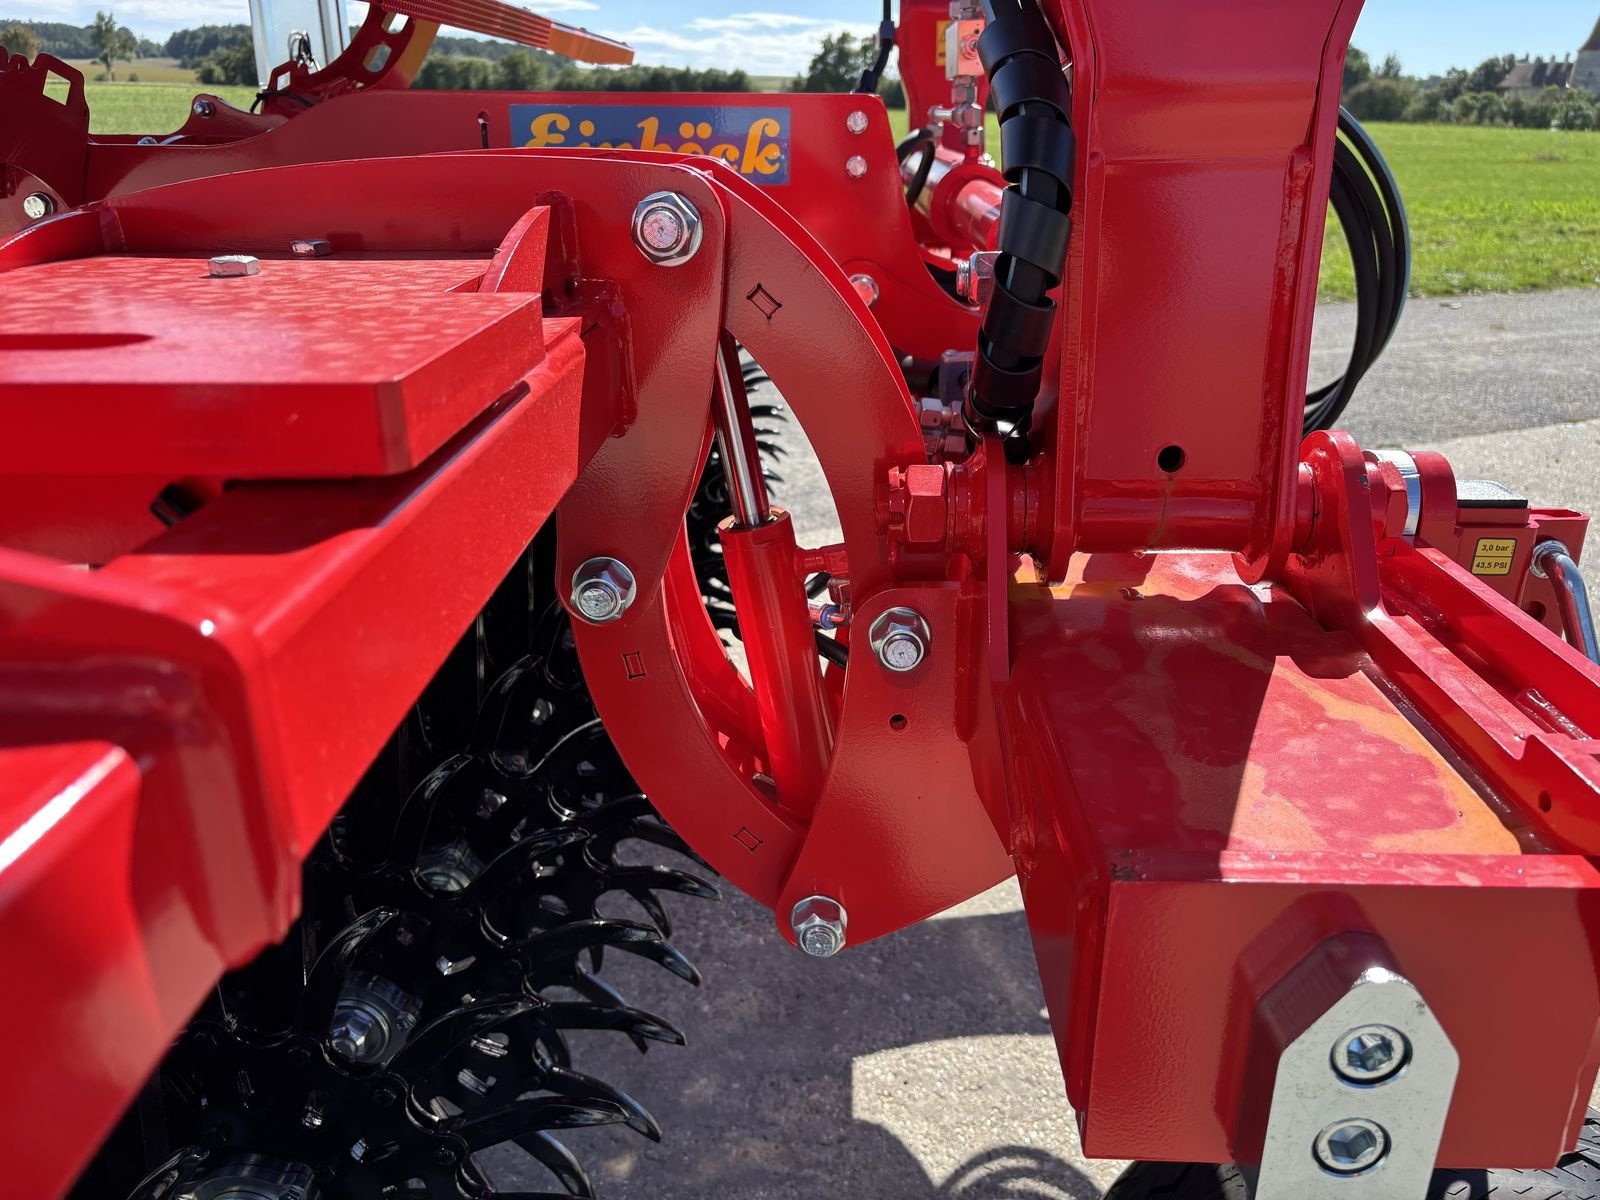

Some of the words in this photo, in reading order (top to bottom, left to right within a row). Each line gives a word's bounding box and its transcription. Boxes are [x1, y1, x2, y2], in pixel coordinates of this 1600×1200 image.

[524, 112, 781, 175] Eiböck
[1481, 544, 1494, 552] 3,0
[1475, 561, 1492, 569] 43,5
[1493, 561, 1508, 569] PSI
